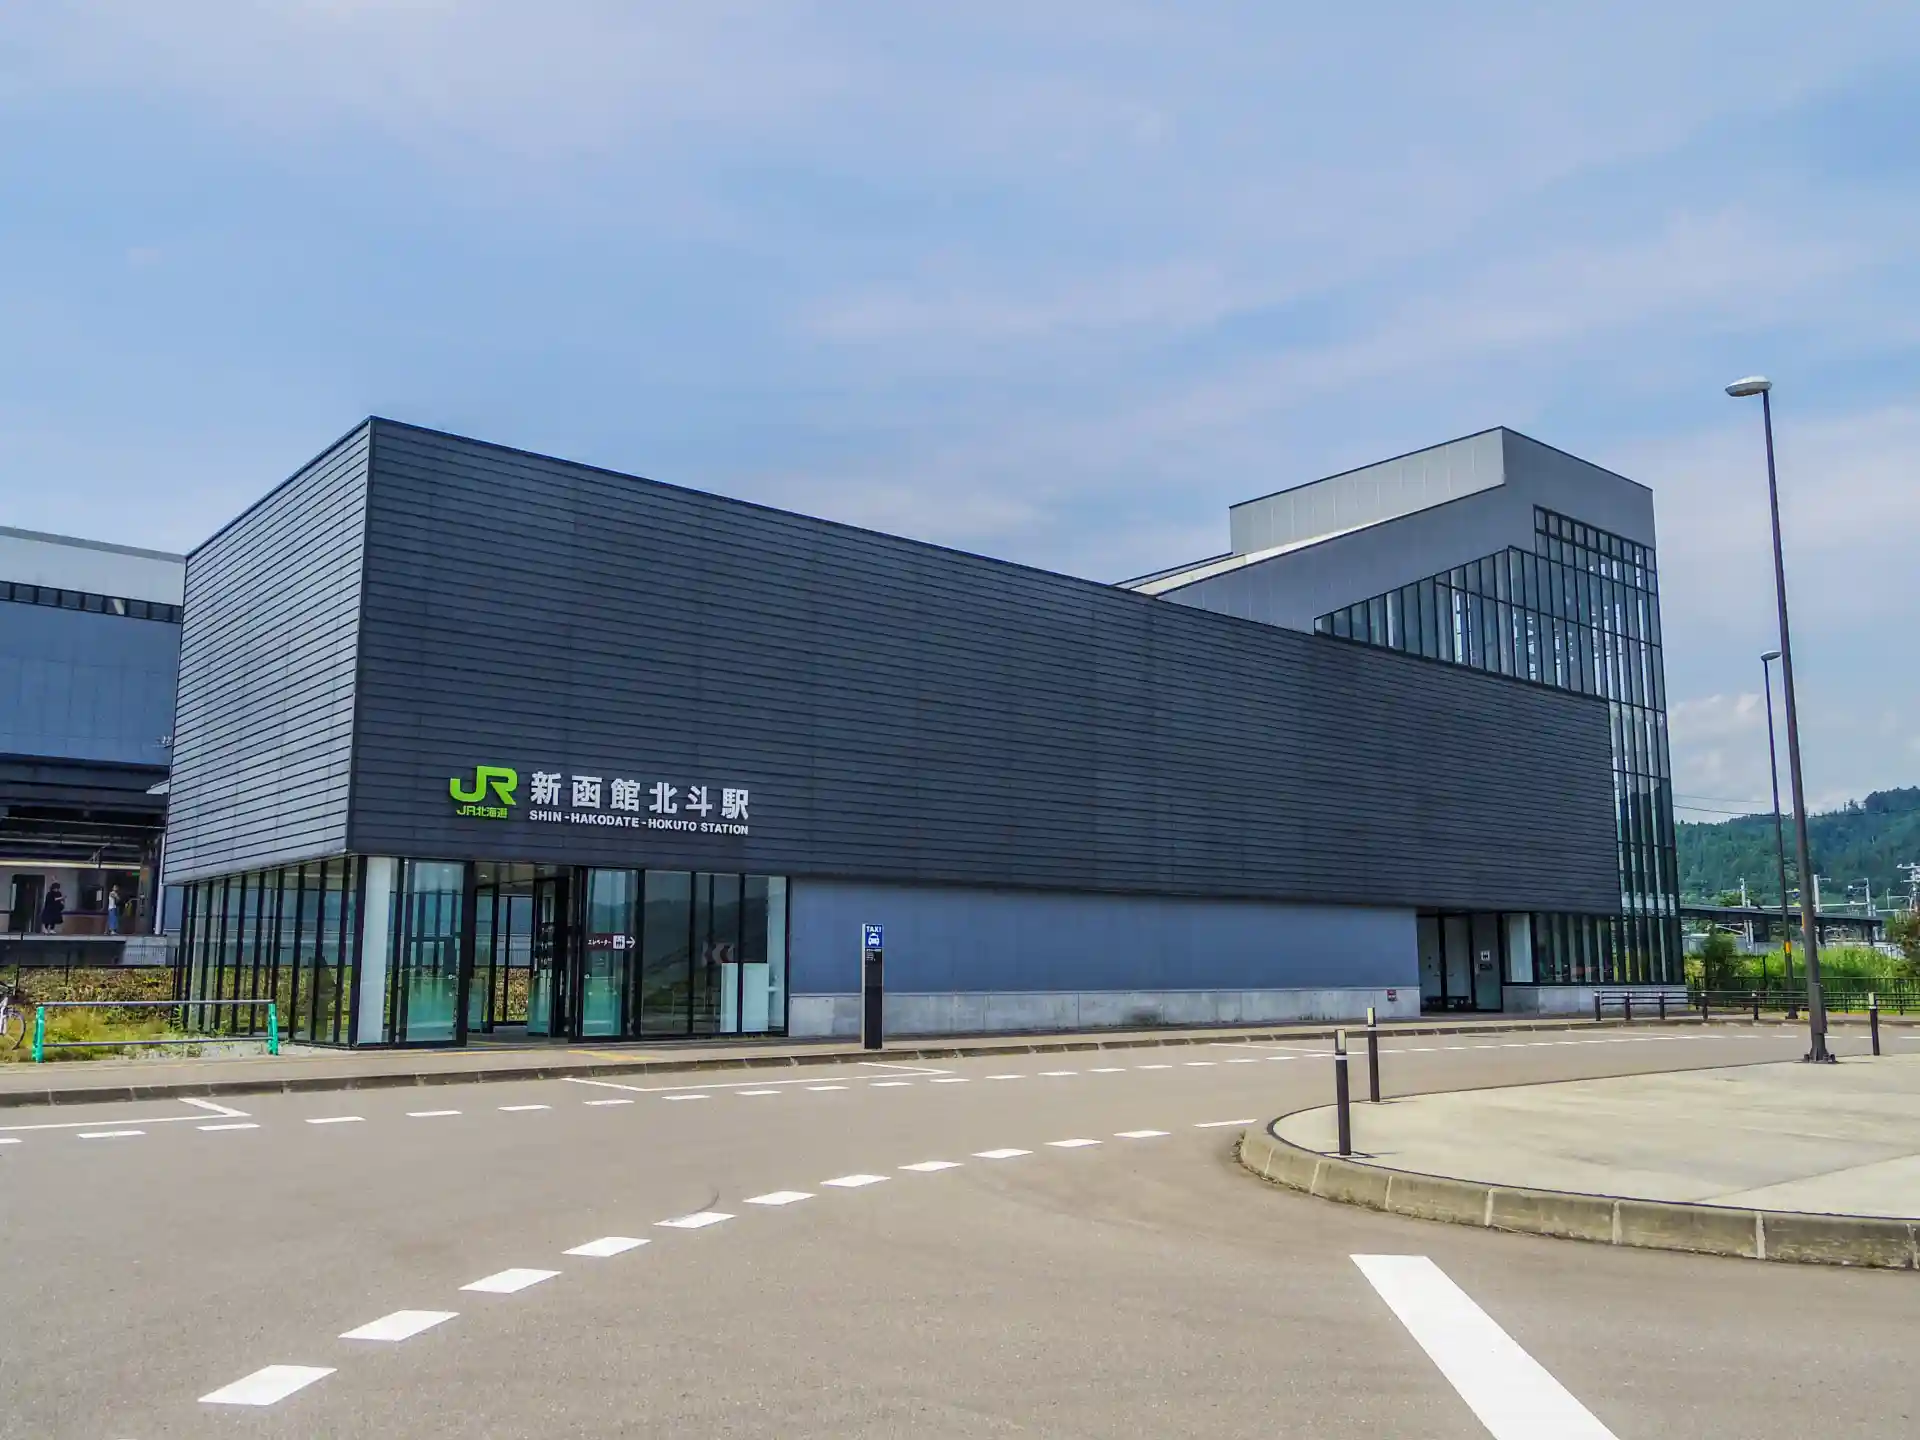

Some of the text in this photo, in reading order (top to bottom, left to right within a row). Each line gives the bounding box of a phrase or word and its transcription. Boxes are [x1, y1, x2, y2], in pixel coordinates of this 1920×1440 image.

[450, 765, 518, 805] JR
[530, 771, 749, 820] 新函館北斗駅
[456, 805, 508, 819] JR北海道
[700, 822, 749, 836] STATION
[866, 925, 882, 933] TAXI
